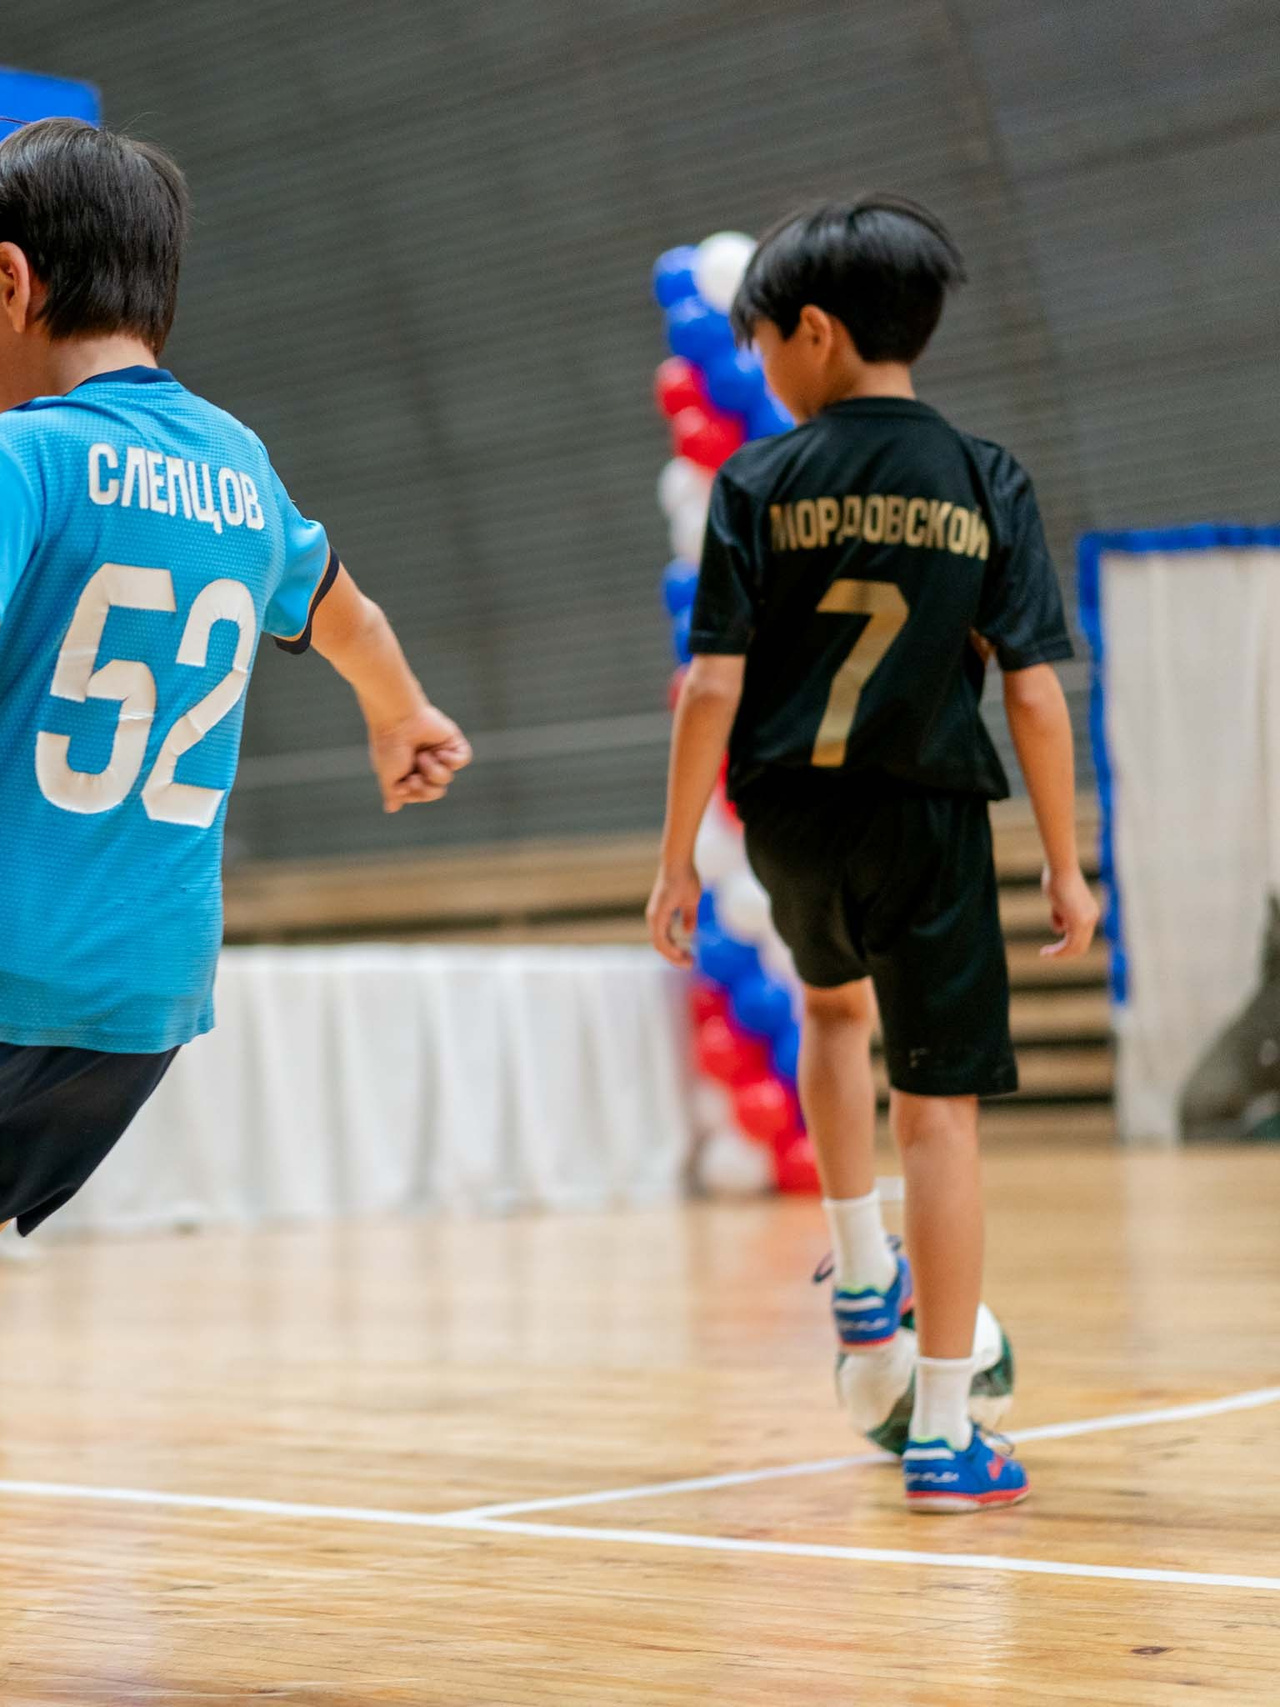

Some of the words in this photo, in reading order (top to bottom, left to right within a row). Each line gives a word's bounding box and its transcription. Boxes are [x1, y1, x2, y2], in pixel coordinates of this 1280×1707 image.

[88, 443, 264, 533] СЛЕПЦОВ
[770, 495, 990, 560] МОРДОВСКОЙ
[35, 563, 255, 829] 52
[811, 578, 909, 767] 7
